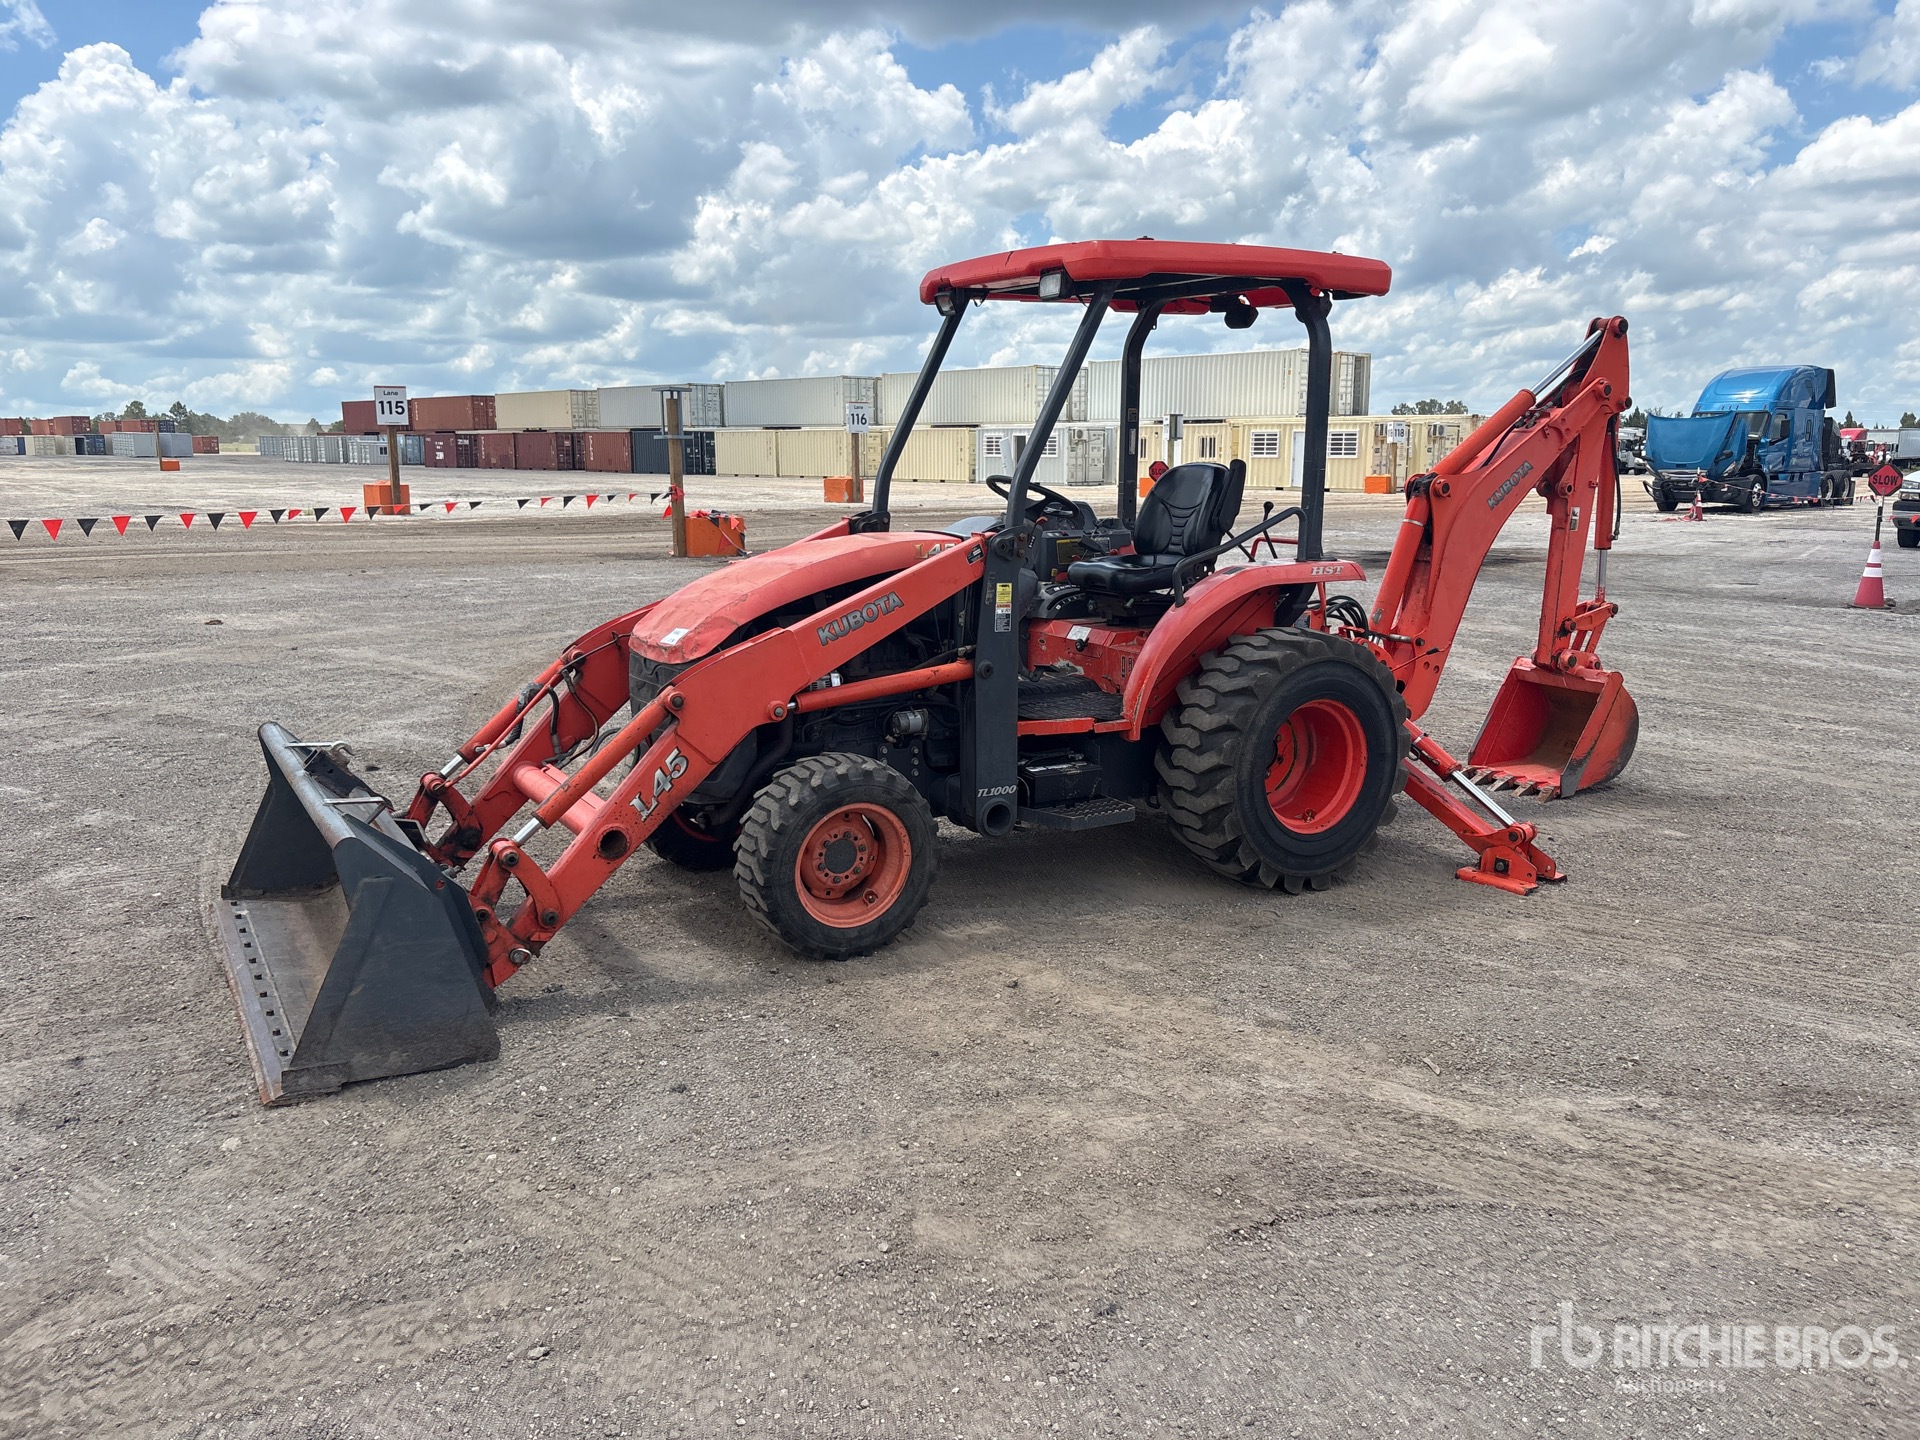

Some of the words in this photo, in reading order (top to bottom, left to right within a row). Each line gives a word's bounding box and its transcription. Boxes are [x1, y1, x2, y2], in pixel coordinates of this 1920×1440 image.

[378, 400, 406, 416] 115
[850, 412, 868, 426] 116
[1394, 428, 1405, 438] 118
[1487, 460, 1534, 511] KUBOTA
[1872, 474, 1899, 486] SLOW
[1311, 565, 1344, 576] HST
[816, 591, 905, 646] KUBOTA
[629, 746, 689, 823] L45
[977, 784, 1018, 798] TL1000
